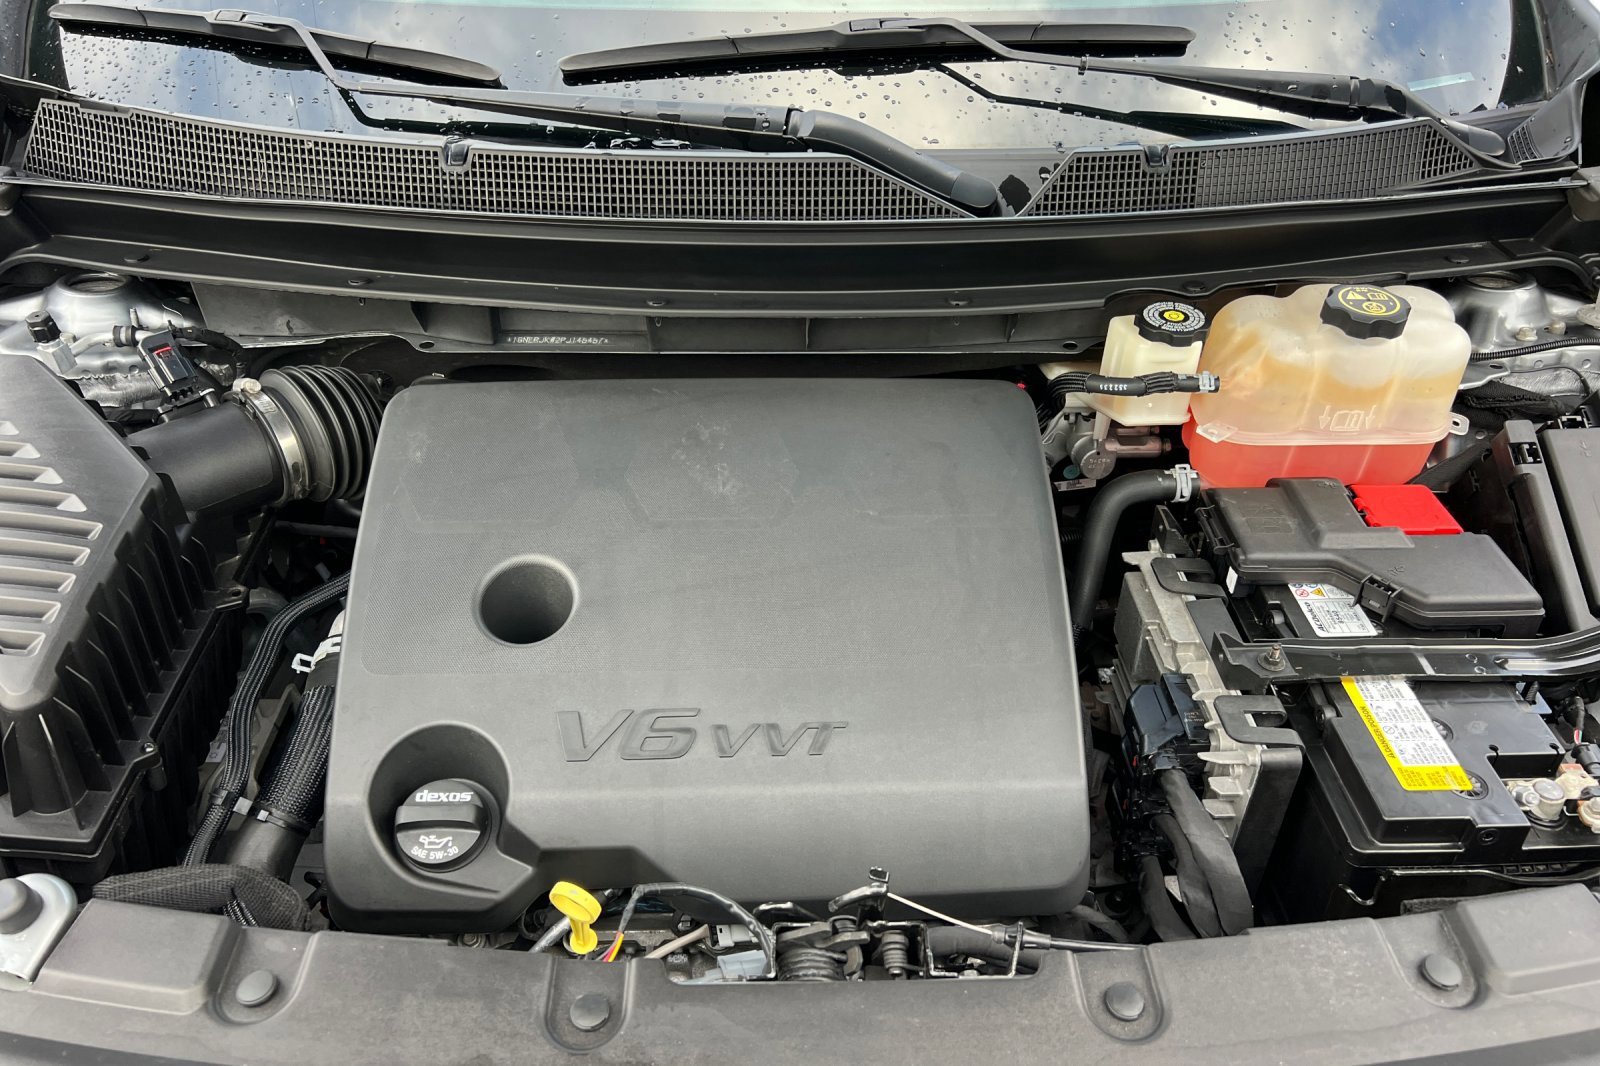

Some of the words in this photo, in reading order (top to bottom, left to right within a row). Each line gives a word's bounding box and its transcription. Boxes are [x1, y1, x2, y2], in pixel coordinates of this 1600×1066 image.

[556, 707, 701, 762] V6
[710, 720, 849, 758] VVT
[415, 789, 474, 802] dexos
[411, 846, 428, 859] SAE
[429, 845, 459, 859] 5W-30
